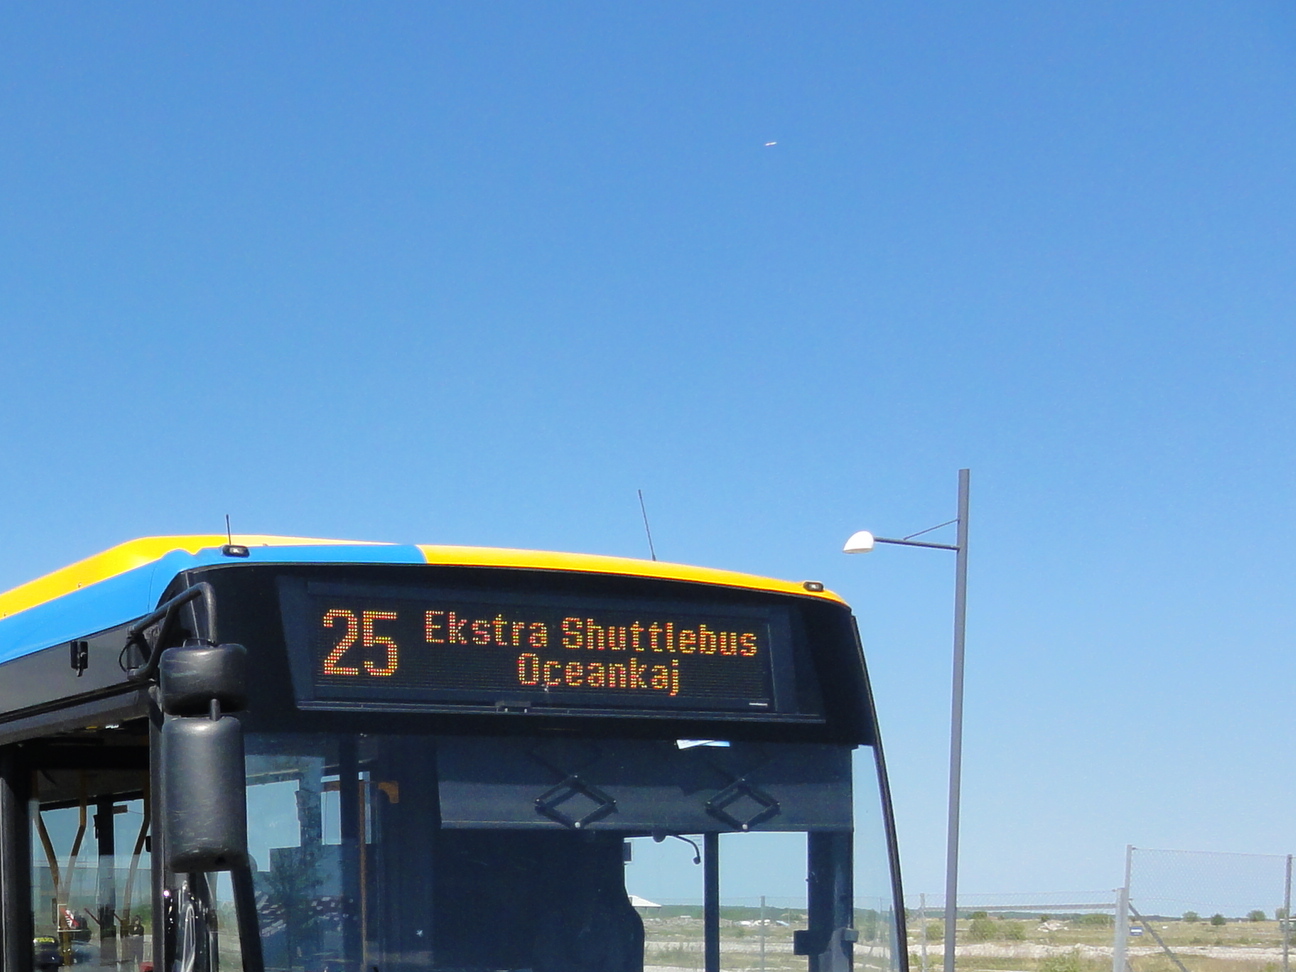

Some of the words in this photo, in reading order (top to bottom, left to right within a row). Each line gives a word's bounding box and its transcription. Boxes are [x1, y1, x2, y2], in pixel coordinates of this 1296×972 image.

[323, 609, 398, 677] 25
[425, 610, 548, 648] Ekstra
[562, 617, 757, 656] Shuttlebus
[518, 653, 680, 696] Oceankaj
